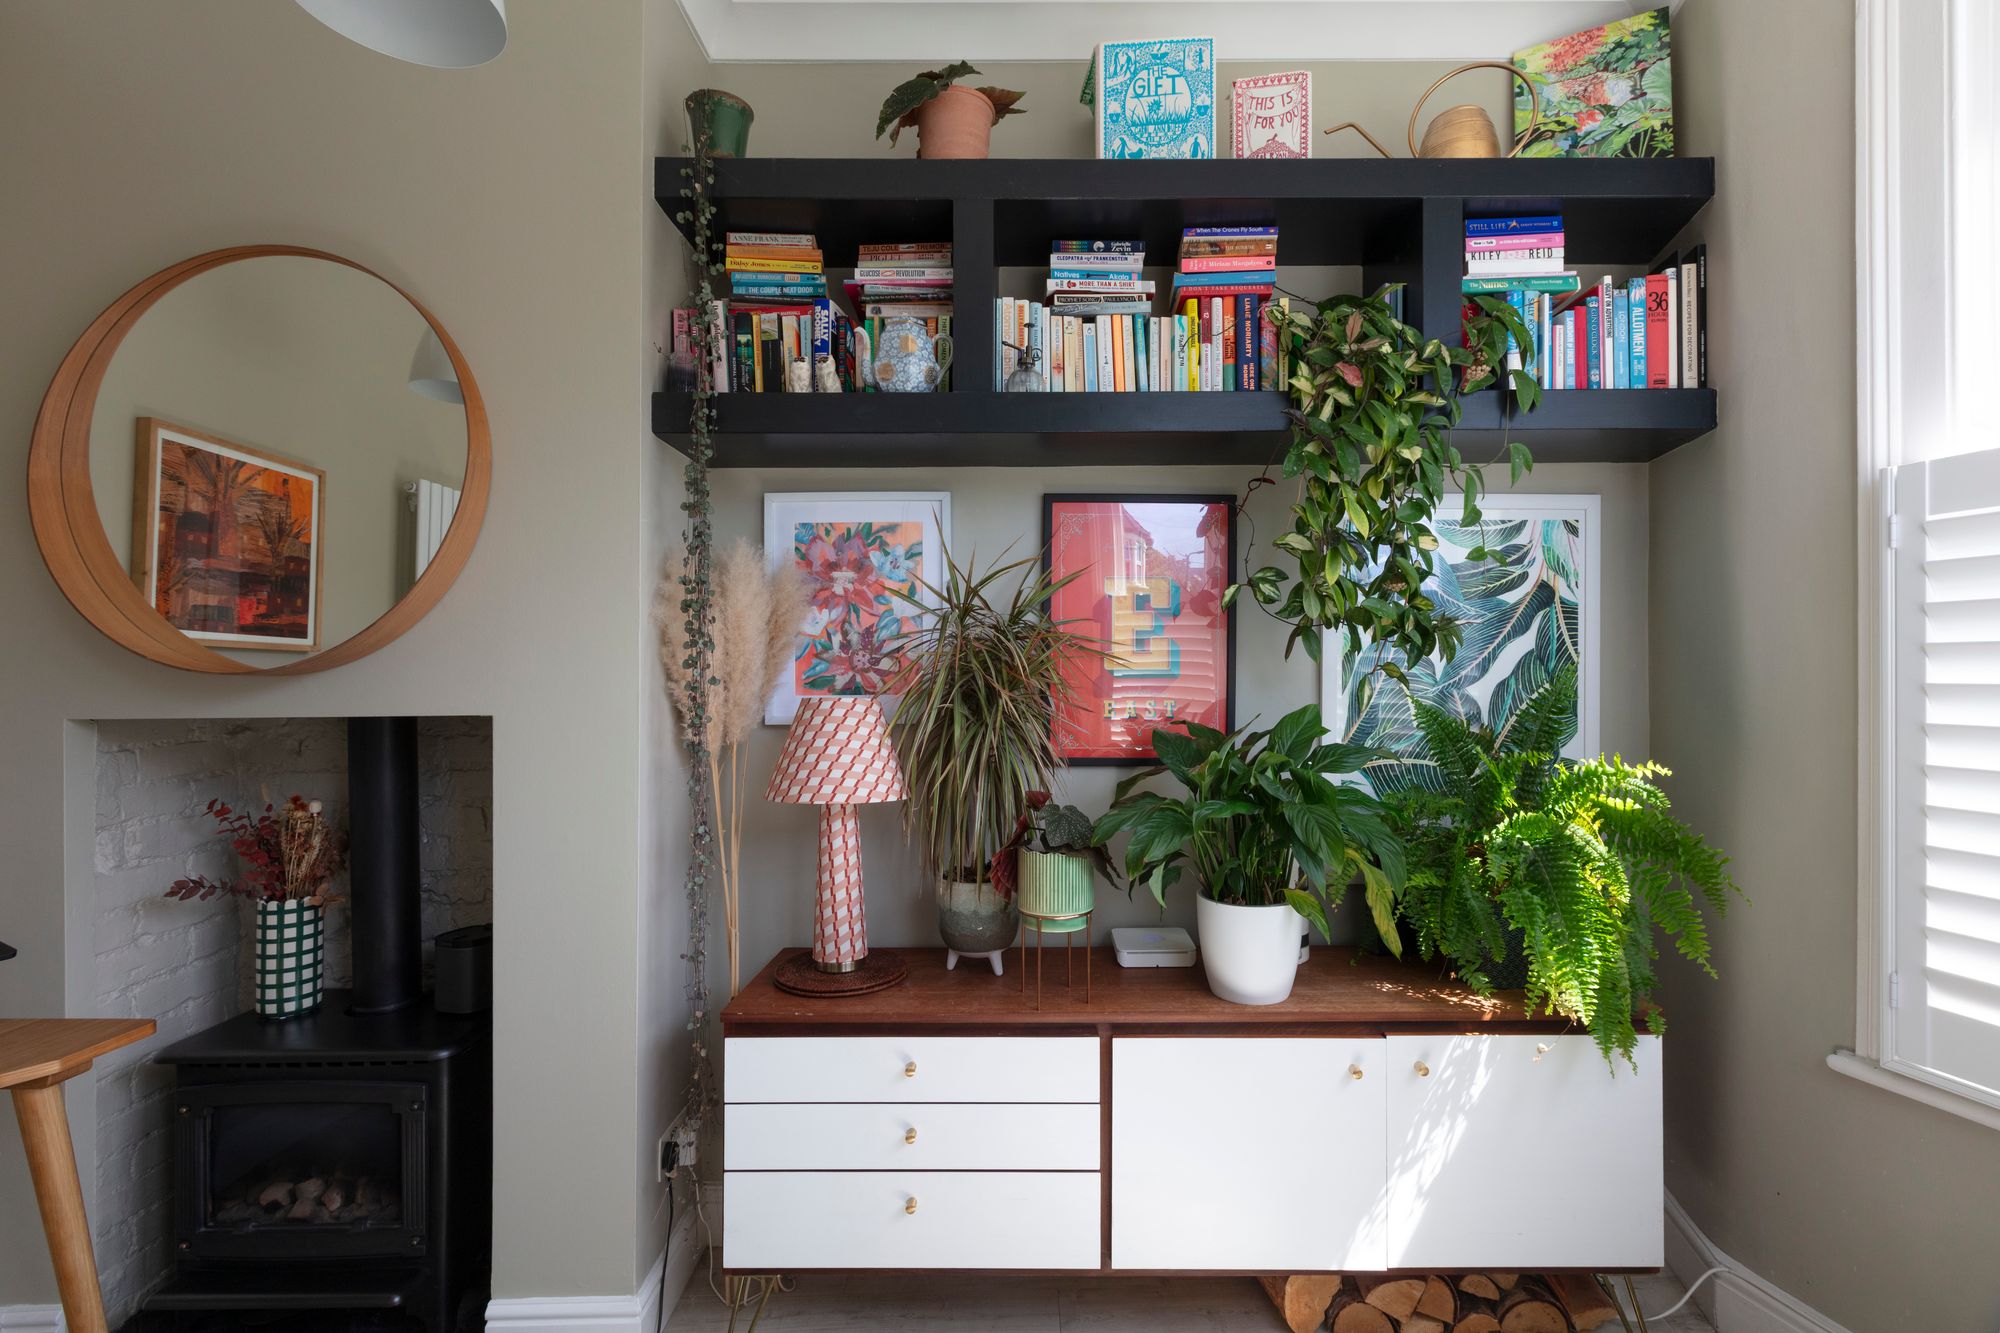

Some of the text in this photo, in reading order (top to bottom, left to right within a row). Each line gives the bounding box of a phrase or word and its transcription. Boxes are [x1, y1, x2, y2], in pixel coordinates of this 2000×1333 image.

[1150, 66, 1167, 77] THE
[1133, 74, 1182, 96] GIFT
[1250, 90, 1294, 111] THIS IS
[1254, 106, 1299, 129] FOR YOU
[1529, 248, 1553, 258] REID
[1479, 280, 1508, 289] Names
[1648, 292, 1668, 312] 36
[1633, 307, 1644, 357] ALLOTMENT
[1104, 576, 1179, 676] E
[1104, 700, 1176, 719] EAST
